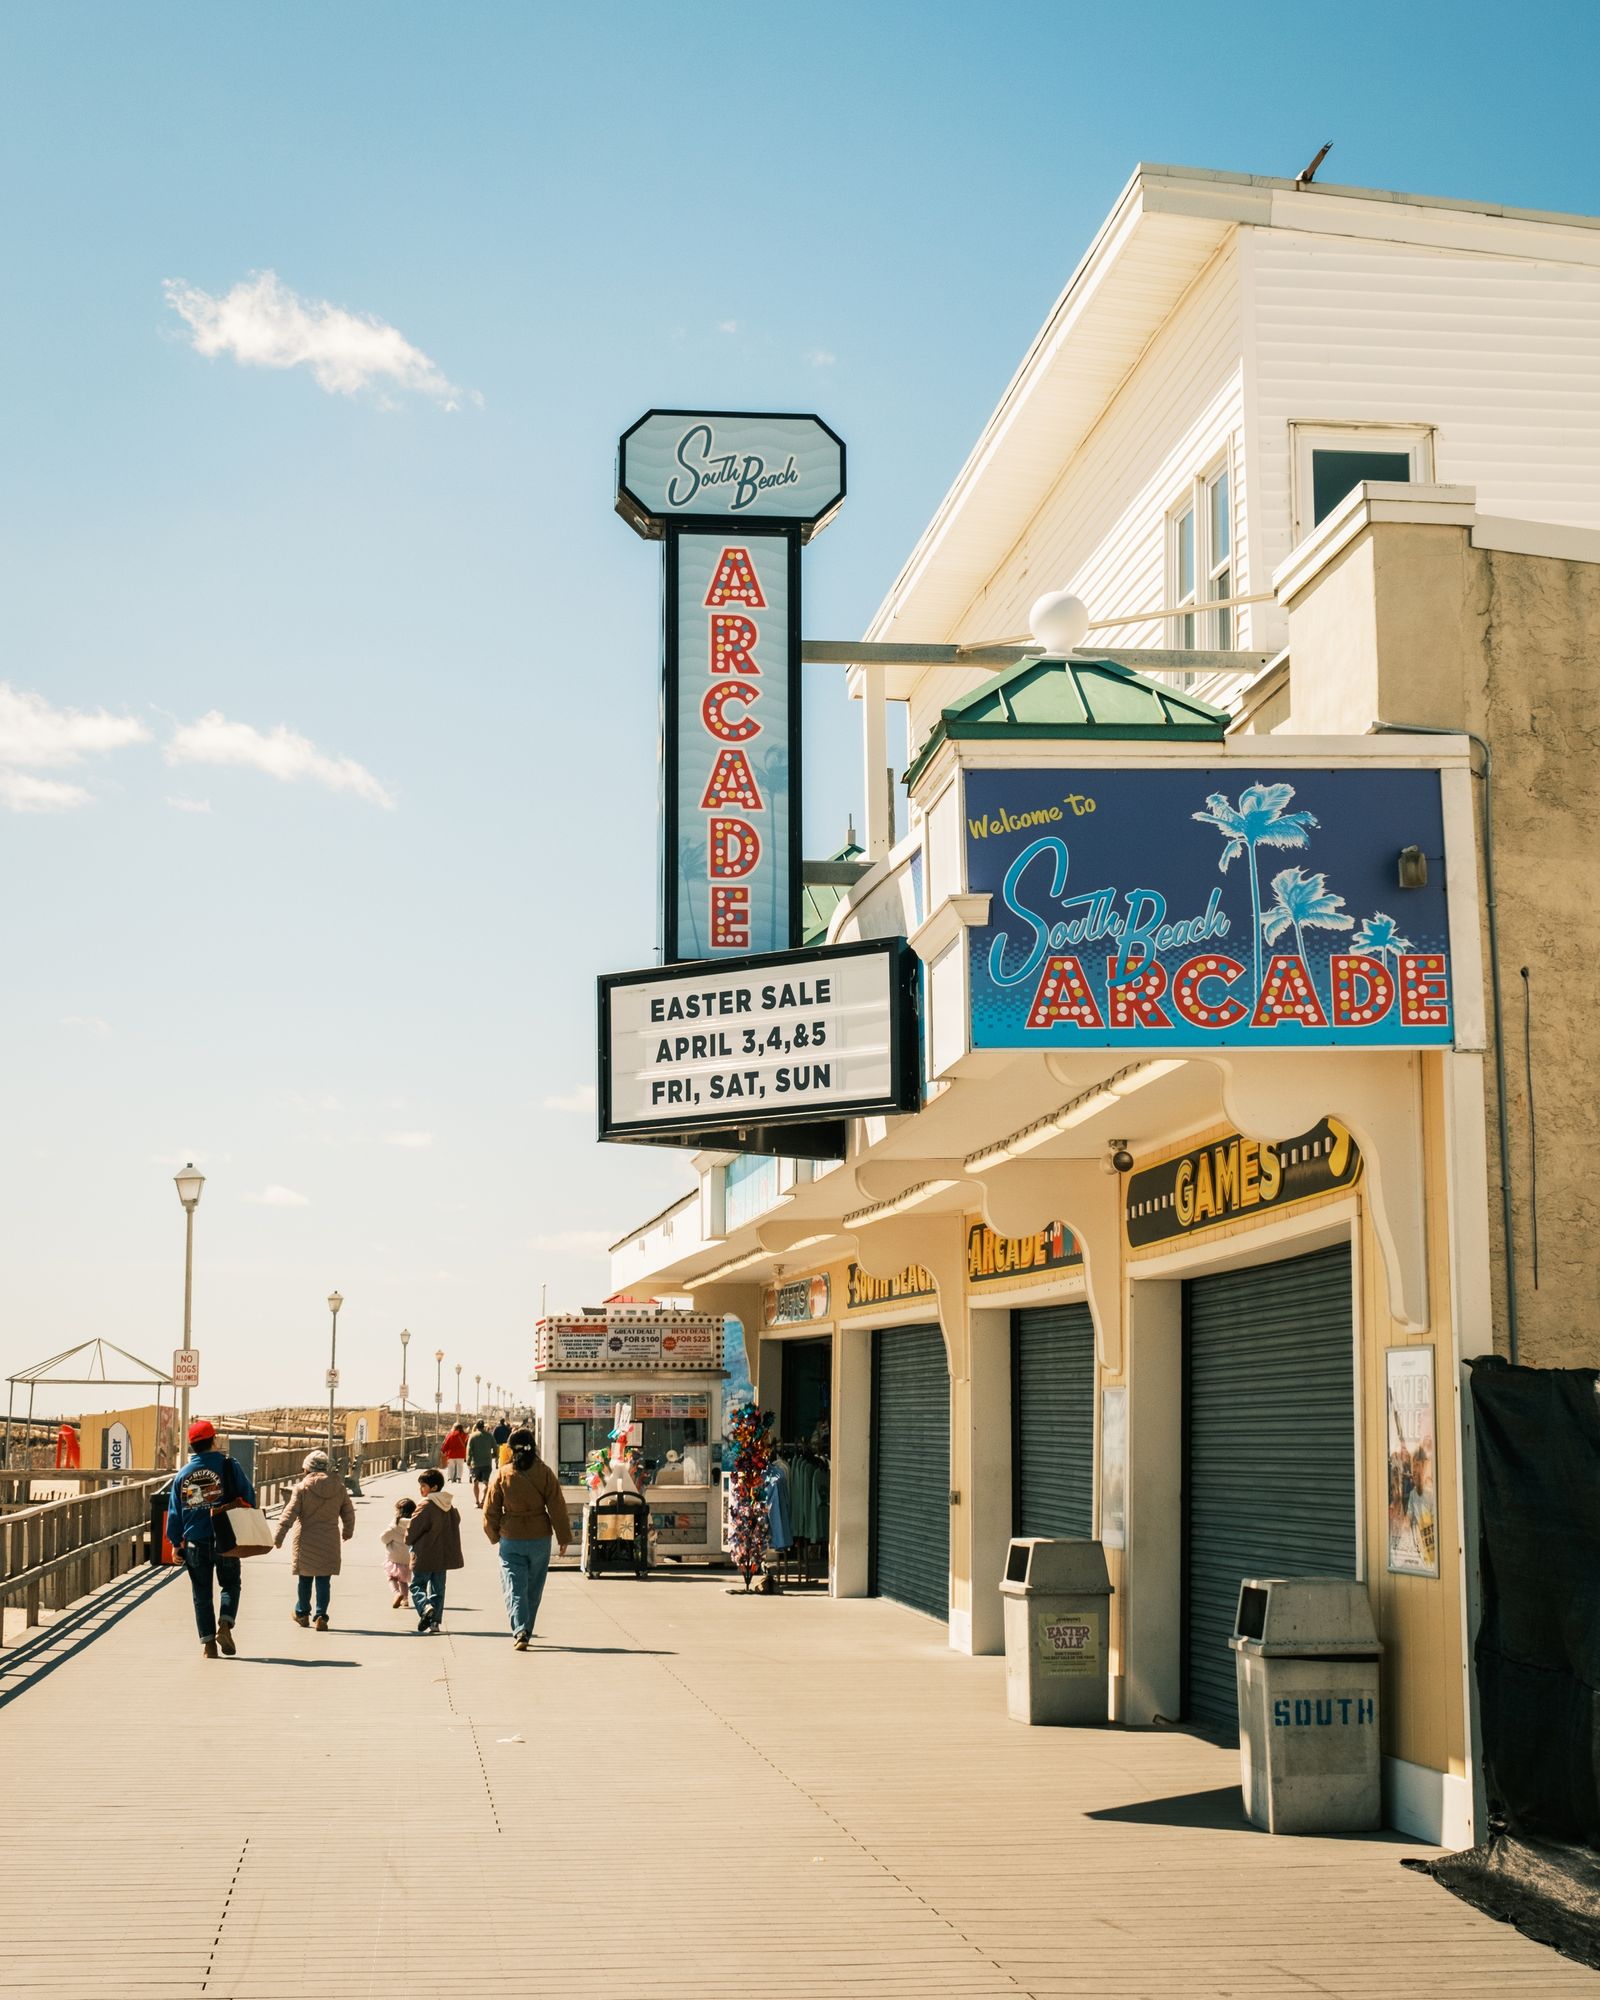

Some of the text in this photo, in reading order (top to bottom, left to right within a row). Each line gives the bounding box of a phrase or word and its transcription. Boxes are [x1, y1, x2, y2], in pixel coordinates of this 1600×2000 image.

[668, 424, 798, 510] South Beach
[703, 547, 767, 948] ARCADE
[968, 793, 1097, 840] Welcome to
[988, 836, 1230, 988] South Beach
[651, 978, 831, 1023] EASTER SALE
[1024, 953, 1448, 1030] ARCADE
[656, 1021, 827, 1063] APRIL 3,4,&5
[652, 1064, 831, 1106] FRI, SAT, SUN
[1174, 1137, 1281, 1227] GAMES
[176, 1365, 196, 1373] DOGS
[180, 1355, 193, 1363] NO
[1046, 1625, 1090, 1640] EASTER
[1054, 1637, 1084, 1649] SALE
[1275, 1698, 1373, 1726] SOUTH
